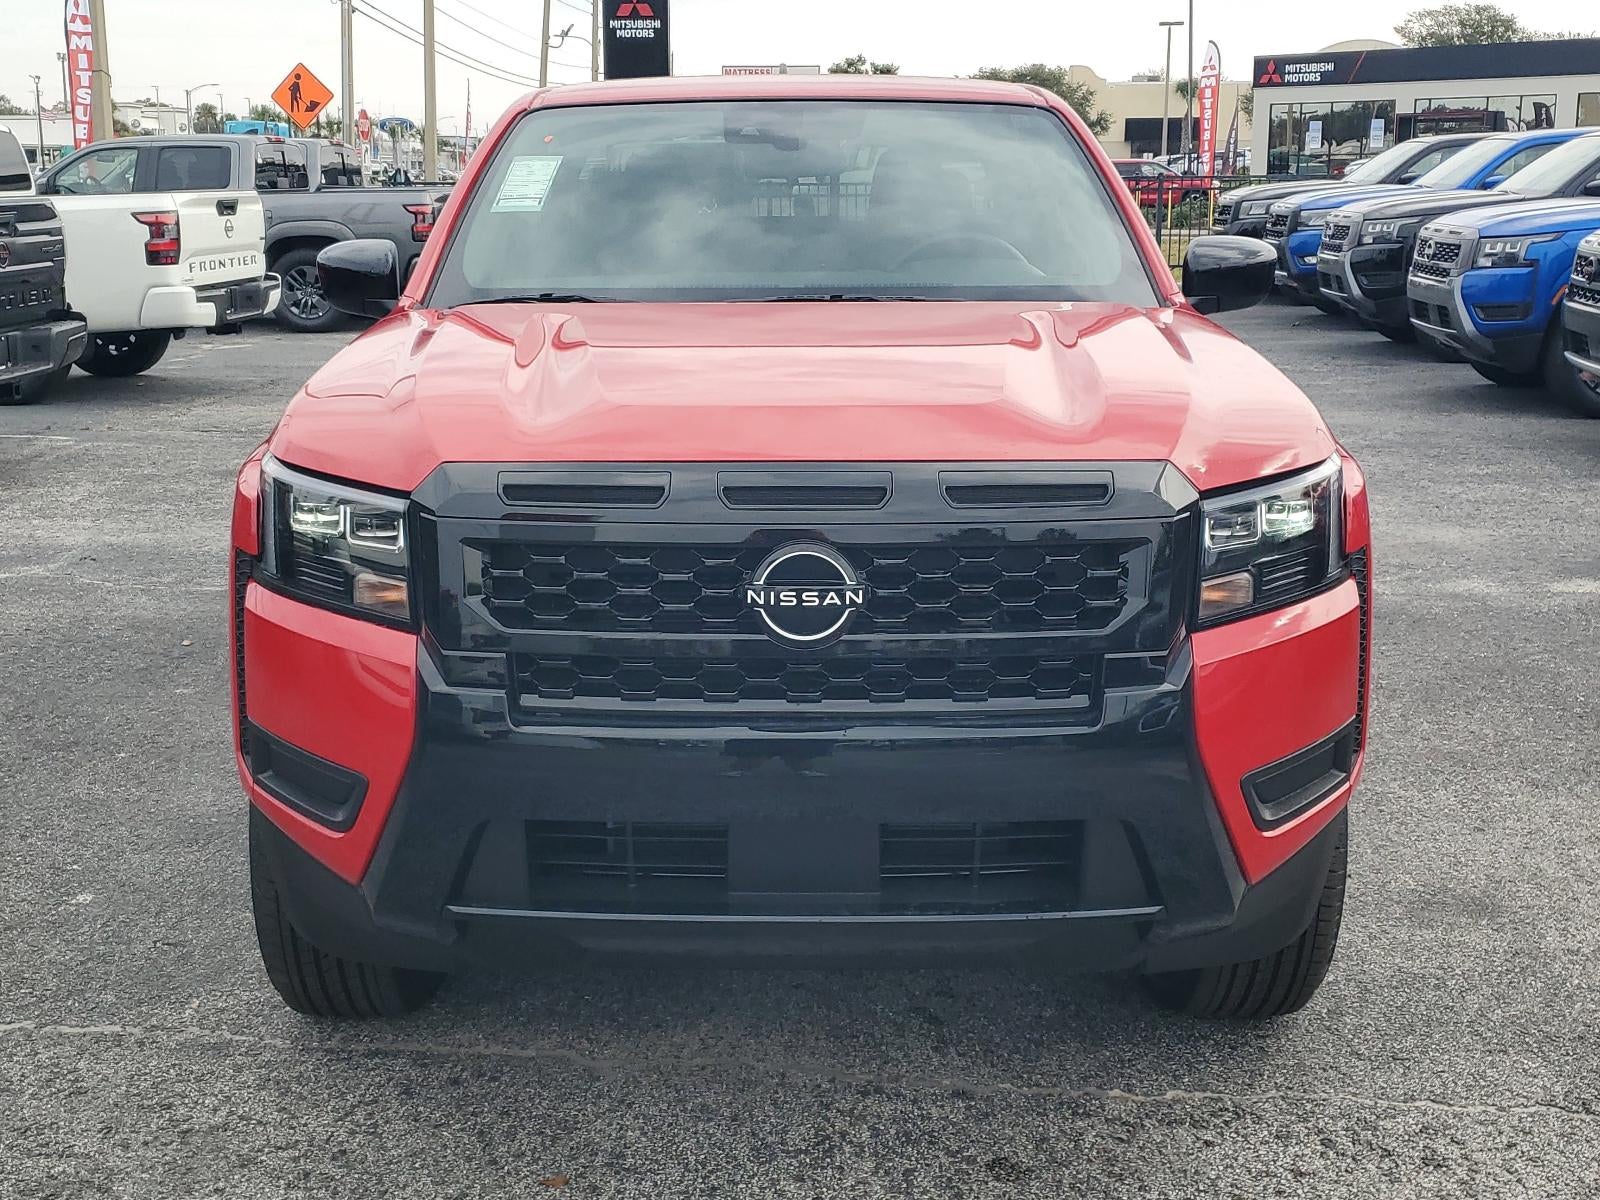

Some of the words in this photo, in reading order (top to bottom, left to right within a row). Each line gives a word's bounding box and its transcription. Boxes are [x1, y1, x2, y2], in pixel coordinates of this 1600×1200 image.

[609, 19, 661, 29] MITSUBISHI
[616, 29, 655, 38] MOTORS
[724, 68, 771, 76] MATTRESS
[1285, 62, 1335, 73] MITSUBISHI
[1284, 73, 1321, 83] MOTORS
[189, 255, 257, 273] FRONTIER
[747, 589, 863, 606] NISSAN
